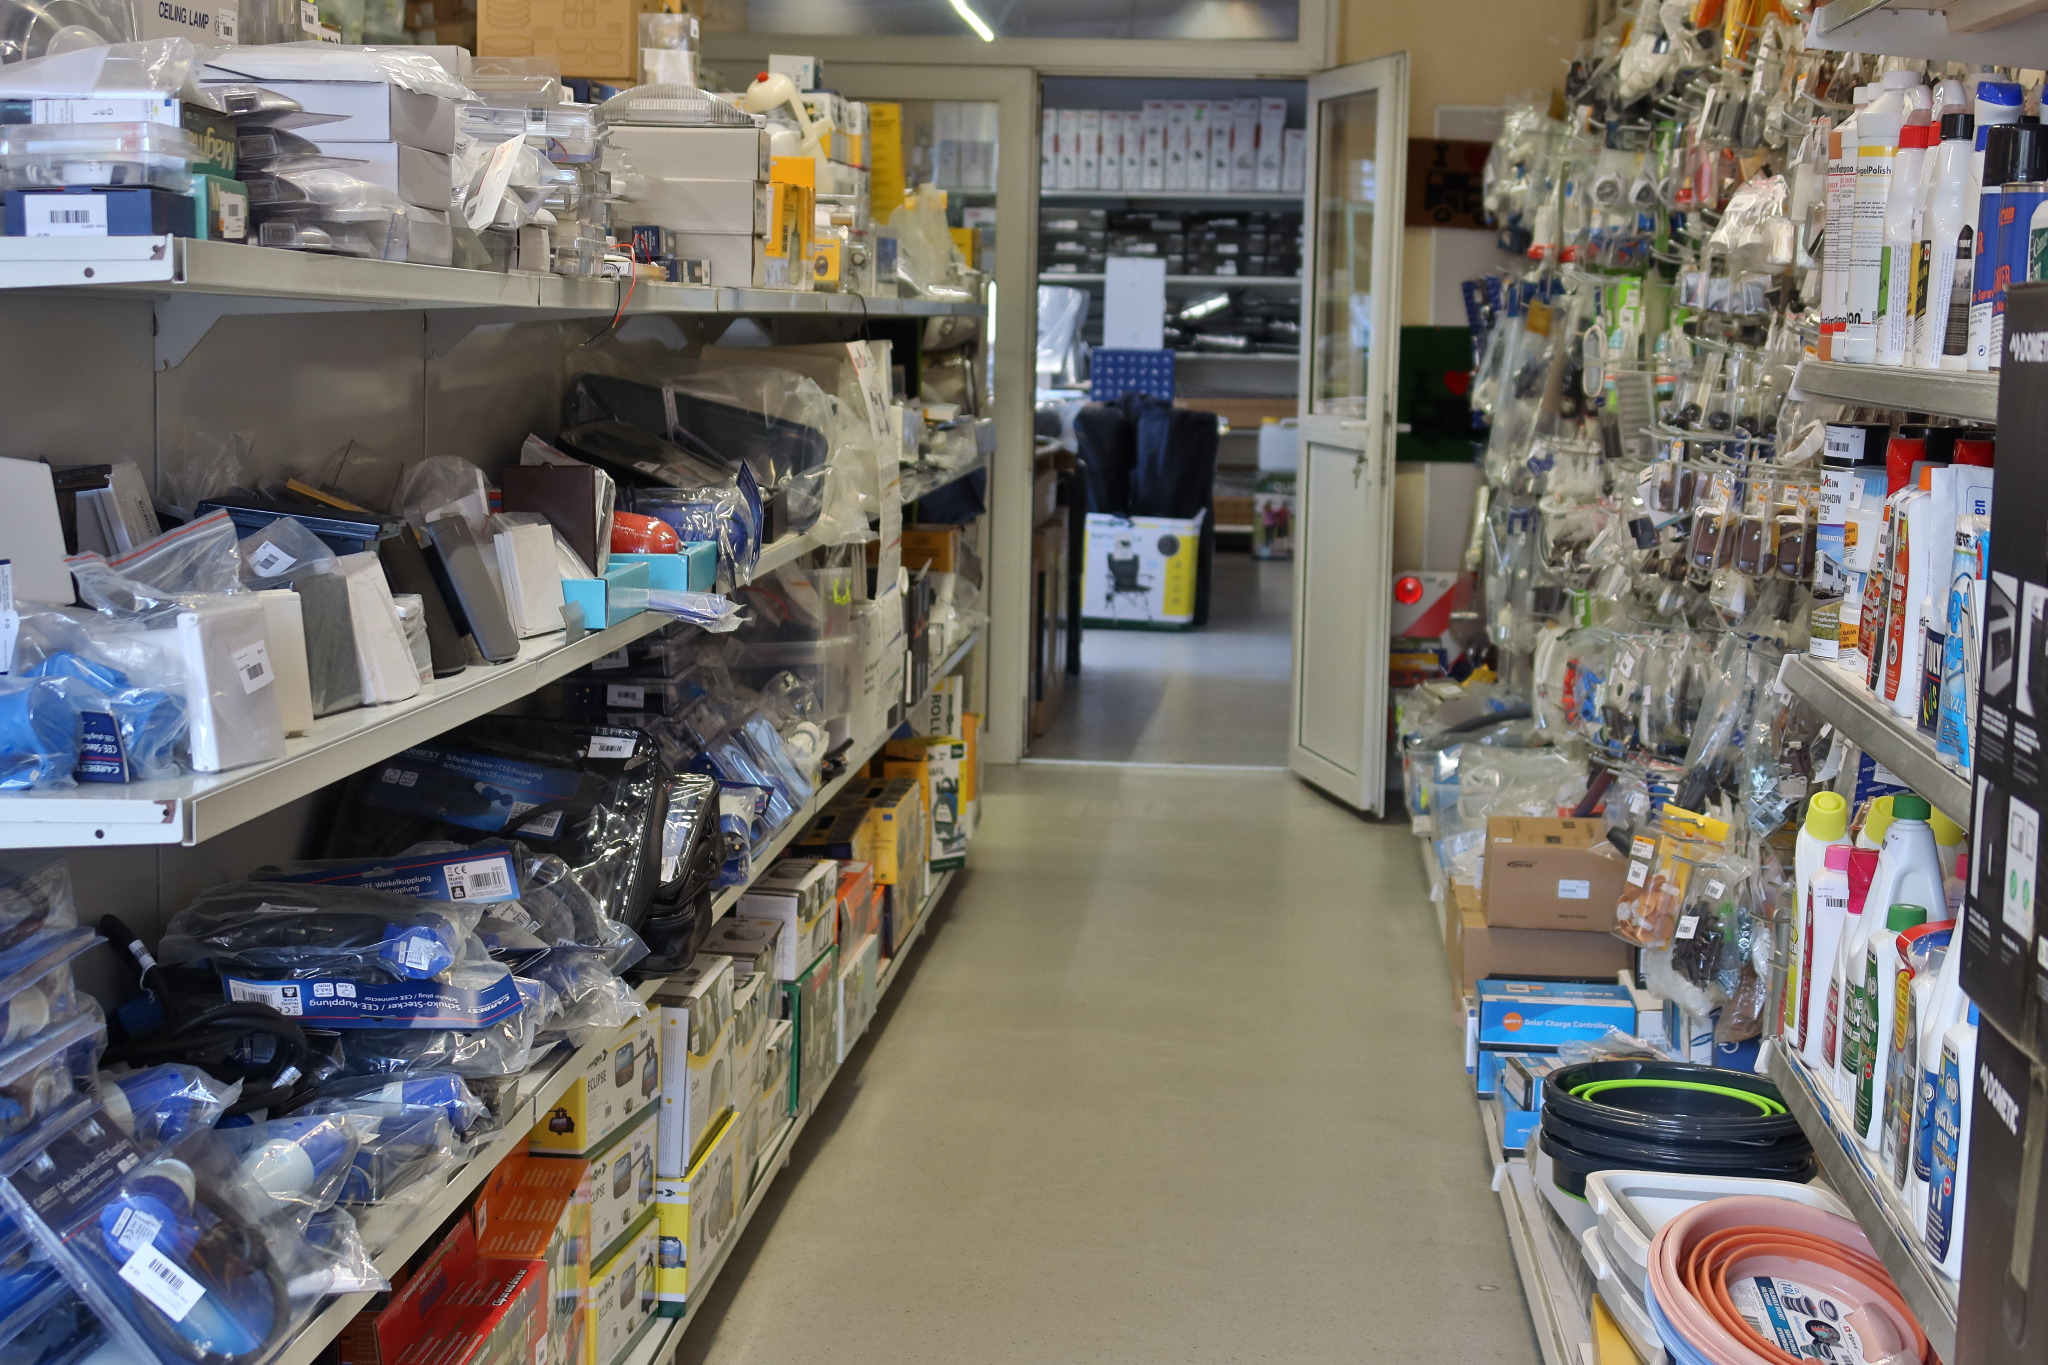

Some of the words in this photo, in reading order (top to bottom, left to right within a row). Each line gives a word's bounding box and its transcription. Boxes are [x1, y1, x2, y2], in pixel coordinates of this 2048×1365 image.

[158, 1, 187, 24] CEILING
[189, 9, 209, 30] LAMP
[442, 761, 466, 773] Schuko
[466, 766, 482, 777] plug
[498, 773, 531, 786] connector
[446, 753, 494, 770] Schuko-Stecker
[498, 764, 544, 780] CEE-Kupplung
[1863, 765, 1876, 773] MOV
[1866, 784, 1888, 793] MOVERA
[454, 865, 468, 875] CE
[309, 999, 380, 1011] CEE-Kupplung
[387, 1000, 462, 1011] Schuko-Stecker
[467, 995, 510, 1014] CARBEST
[435, 994, 459, 1004] Schuko
[1524, 1018, 1544, 1027] Solar
[1545, 1019, 1572, 1029] Charge
[1573, 1020, 1610, 1030] Controller
[587, 1069, 607, 1093] ECLIPSE
